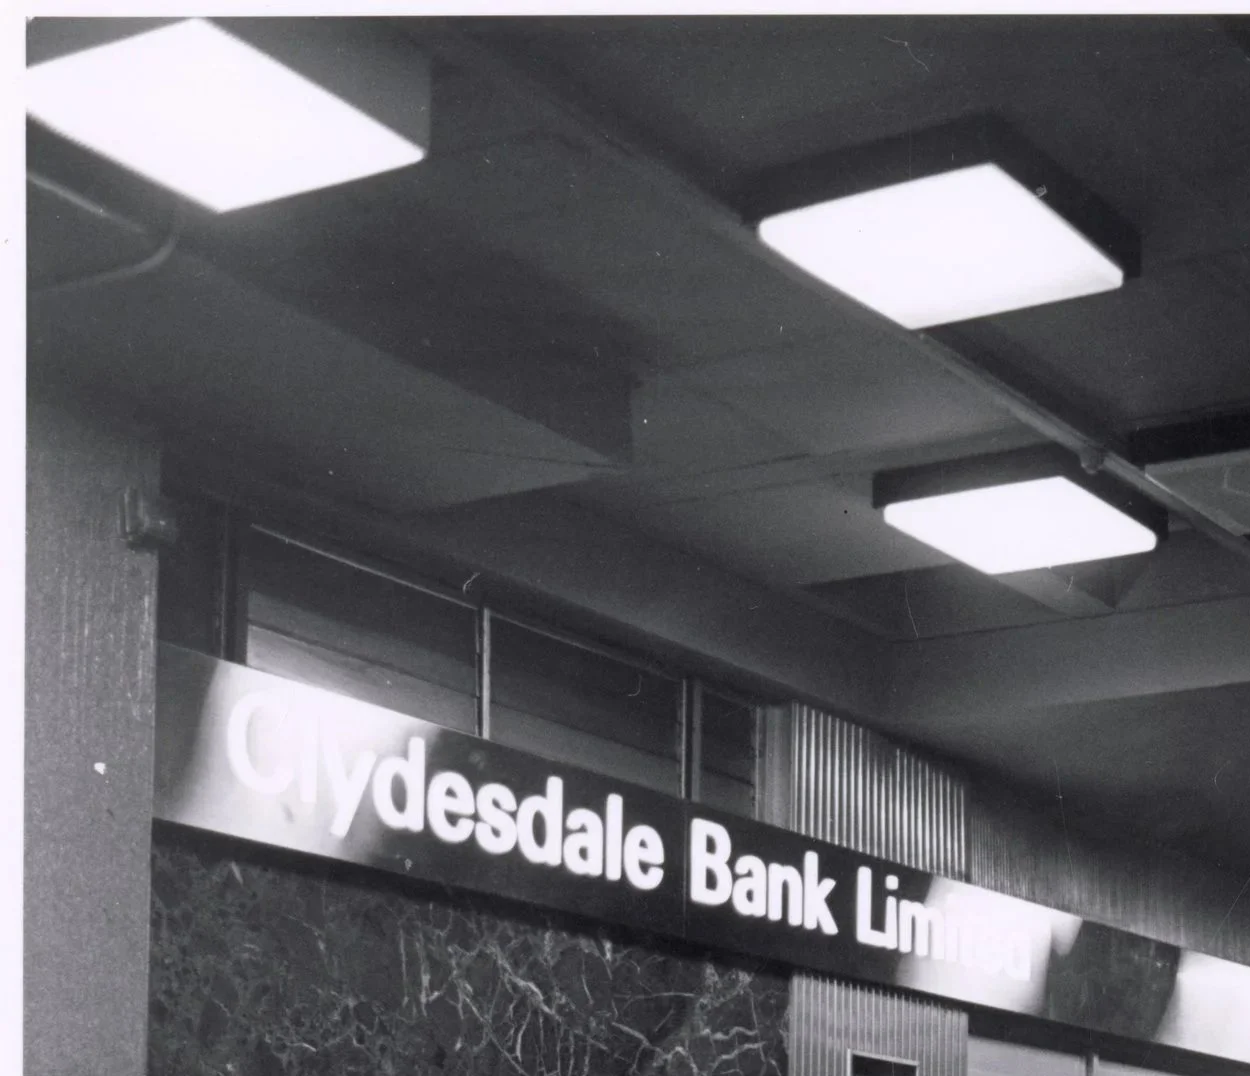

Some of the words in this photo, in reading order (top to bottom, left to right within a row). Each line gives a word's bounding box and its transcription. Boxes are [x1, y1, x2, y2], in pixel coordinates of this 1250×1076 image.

[227, 686, 664, 891] Clydesdale
[690, 816, 839, 935] Bank
[858, 867, 1031, 980] Limd
